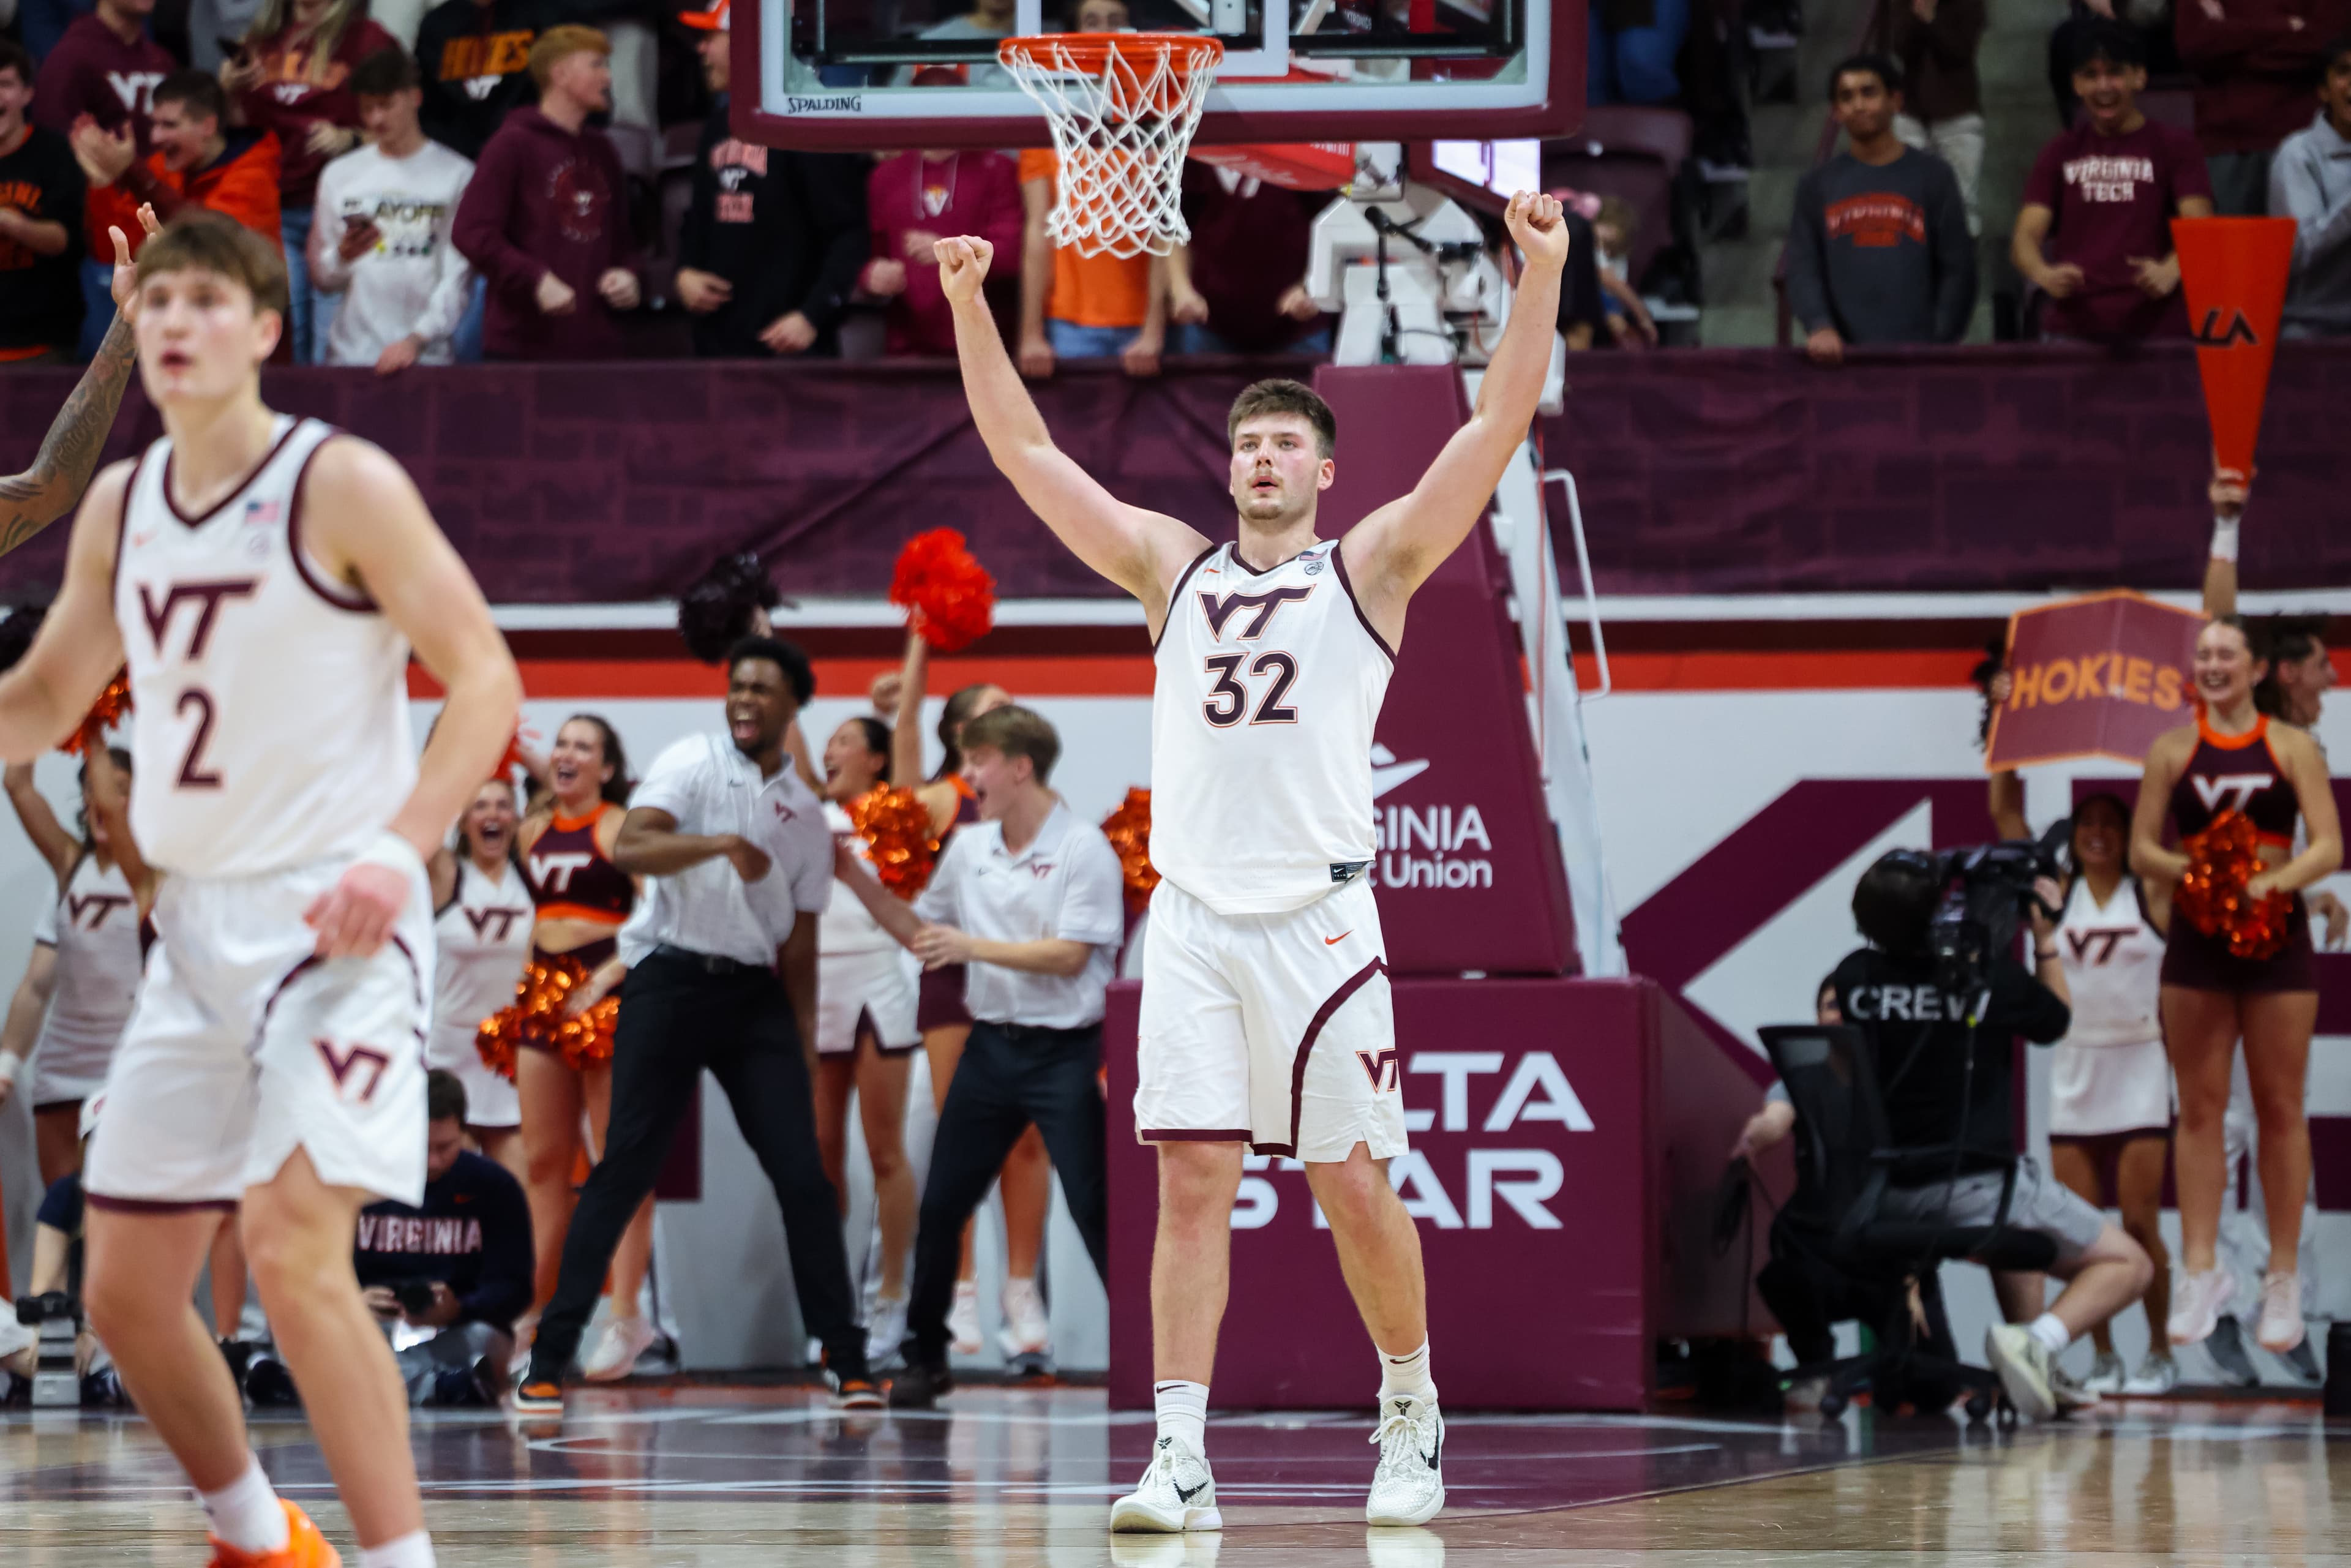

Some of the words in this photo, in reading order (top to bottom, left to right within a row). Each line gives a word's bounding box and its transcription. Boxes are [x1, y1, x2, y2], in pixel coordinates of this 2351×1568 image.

[108, 71, 165, 114] VT
[788, 96, 861, 114] SPALDING
[2063, 156, 2154, 184] VIRGINIA
[2082, 182, 2135, 203] TECH
[136, 576, 267, 661] VT
[1196, 583, 1317, 643] VT
[1202, 650, 1299, 728] 32
[2009, 652, 2186, 713] HOKIES
[174, 685, 225, 790] 2
[2192, 774, 2274, 813] VT
[529, 852, 594, 893] VT
[1030, 863, 1057, 880] VT
[1382, 851, 1493, 888] Union
[69, 892, 132, 929] VT
[462, 907, 528, 945] VT
[2064, 928, 2140, 967] VT
[1848, 983, 1992, 1023] CREW
[316, 1038, 390, 1104] VT
[358, 1215, 482, 1254] VIRGINIA
